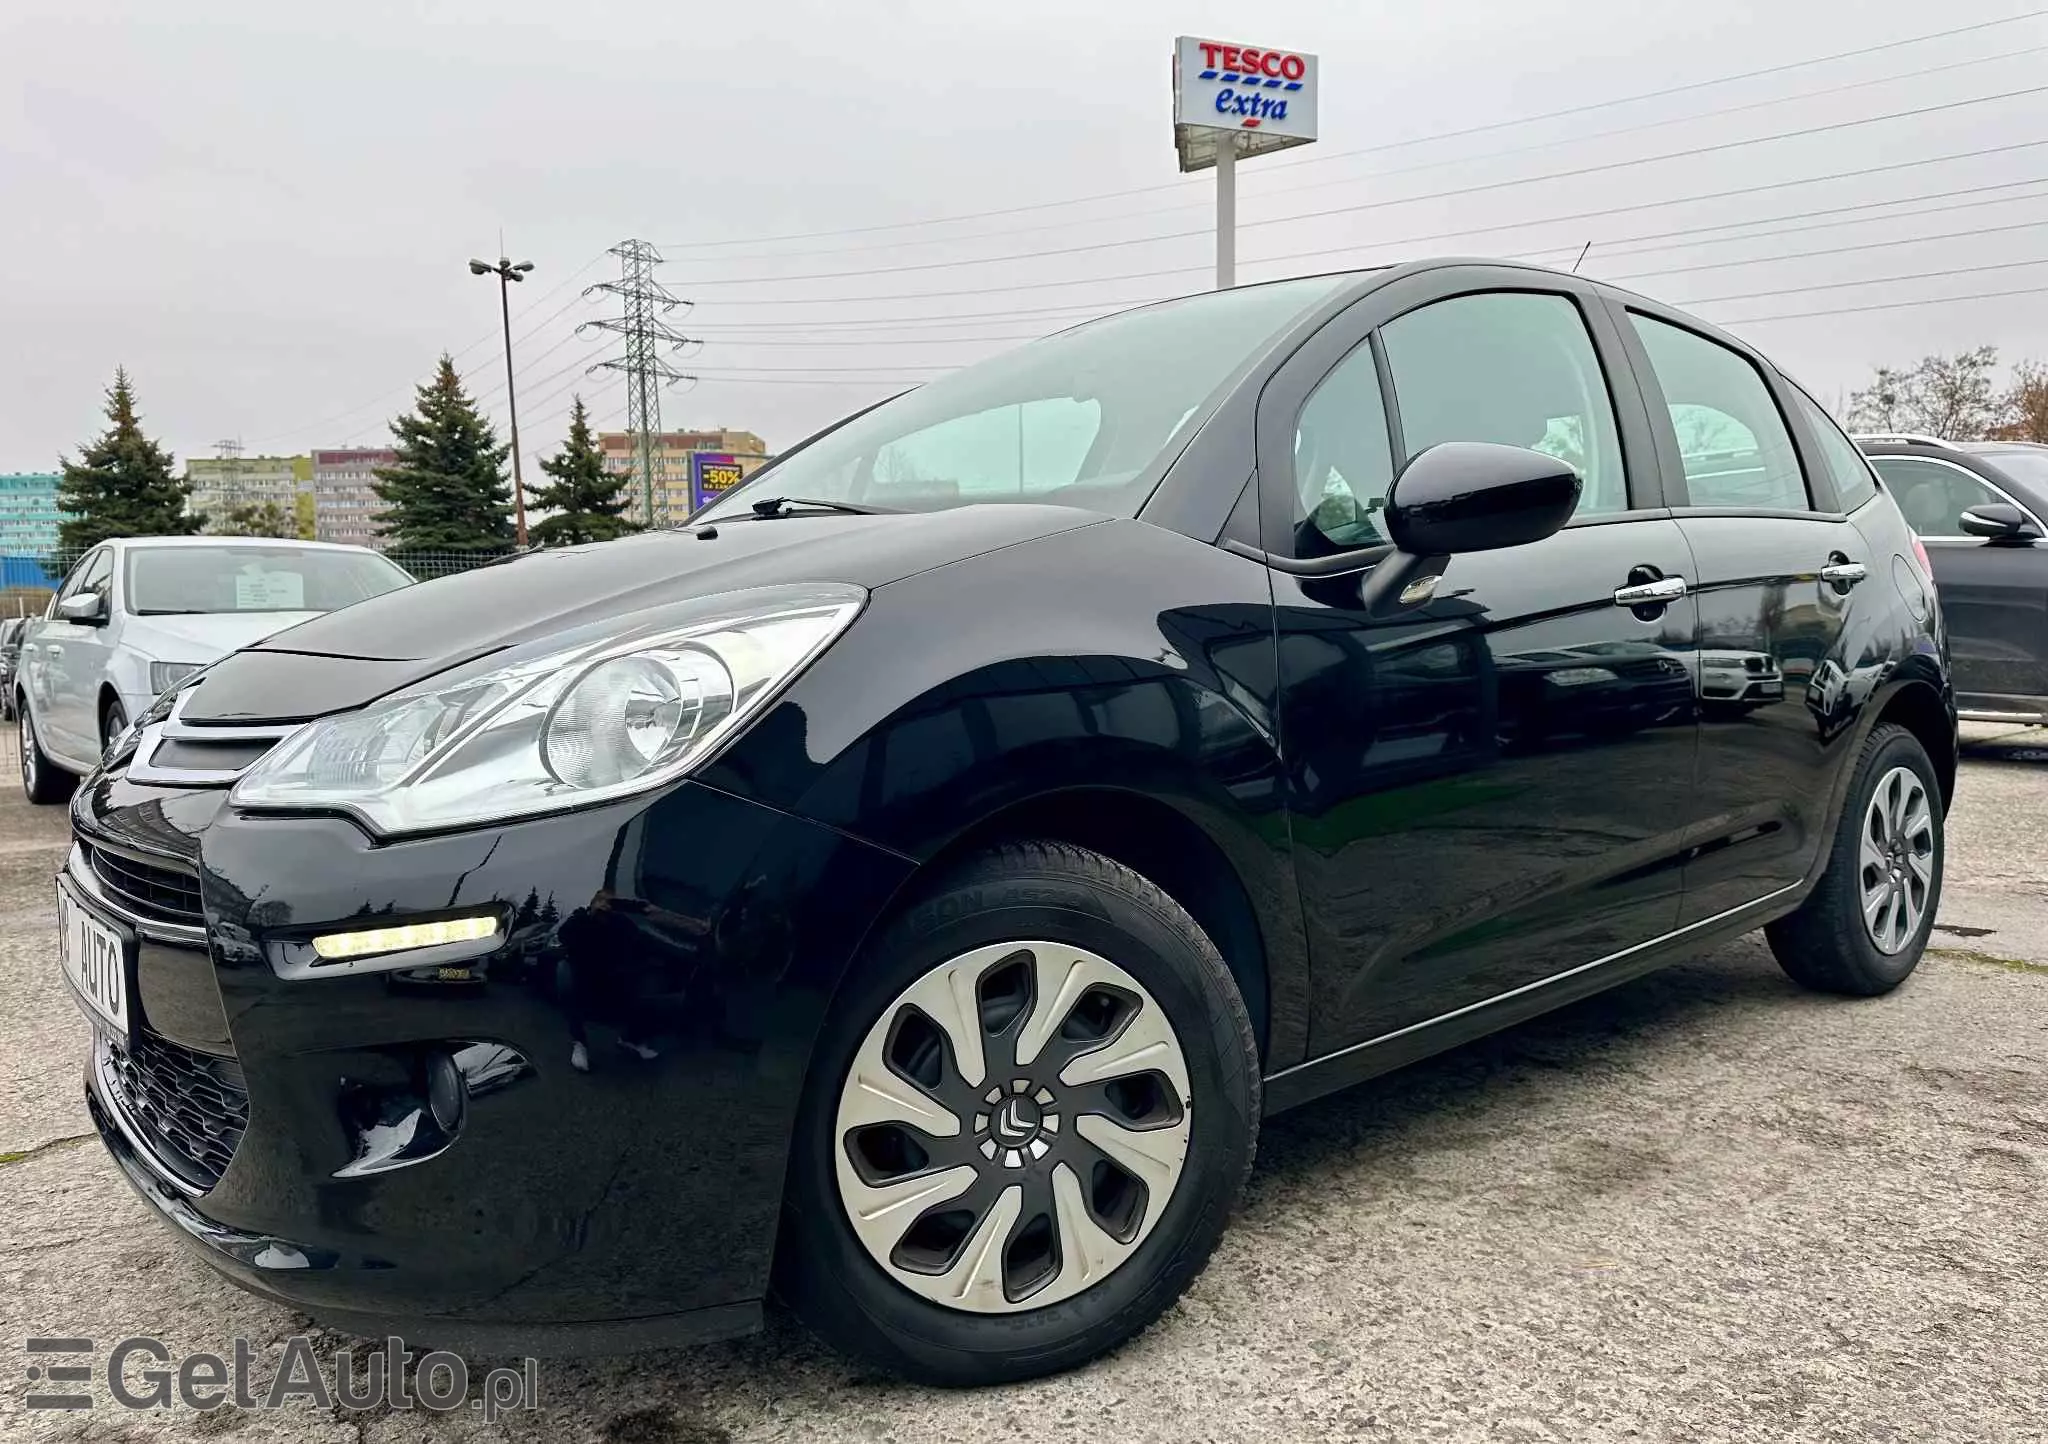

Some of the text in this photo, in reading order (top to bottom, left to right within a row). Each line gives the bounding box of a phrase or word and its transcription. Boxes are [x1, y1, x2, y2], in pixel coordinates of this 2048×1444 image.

[1199, 42, 1306, 81] TESCO
[1215, 88, 1288, 120] extra
[81, 920, 120, 1016] AUTO
